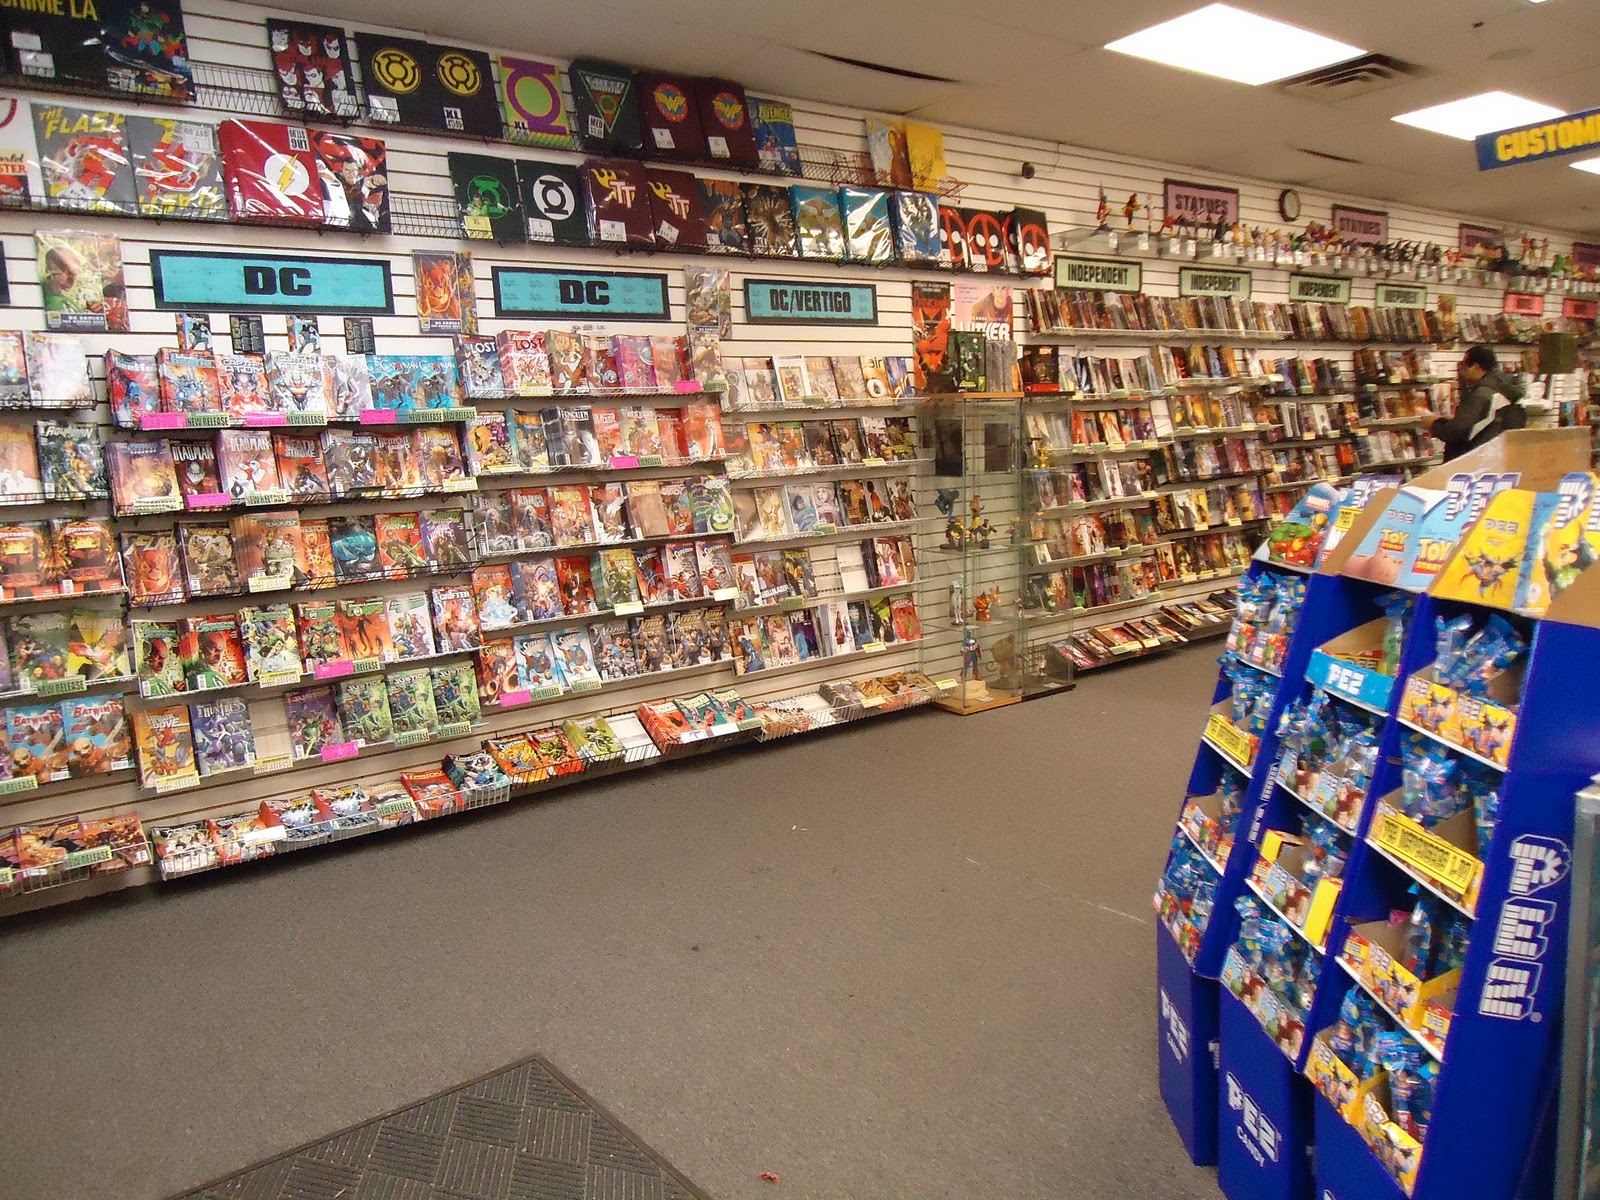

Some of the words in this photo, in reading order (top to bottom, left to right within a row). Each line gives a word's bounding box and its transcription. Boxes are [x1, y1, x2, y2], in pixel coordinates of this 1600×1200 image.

[1175, 193, 1230, 217] STATUES
[243, 265, 313, 298] DC
[1067, 263, 1129, 286] INDEPENDENT
[1190, 273, 1242, 293] INDEPENDENT
[558, 278, 610, 306] DC
[769, 287, 852, 314] DC/VERTIGO
[470, 341, 497, 354] LOST
[514, 337, 544, 350] LOST
[224, 365, 265, 374] ATOM
[203, 416, 229, 427] RELEASE
[301, 415, 326, 425] RELEASE
[421, 412, 443, 422] RELEASE
[454, 410, 476, 420] RELEASE
[285, 448, 316, 459] STROKE
[1387, 508, 1416, 525] PEZ
[1484, 518, 1519, 534] PEZ
[1380, 528, 1410, 544] TOY
[1419, 537, 1453, 562] TOY
[1414, 560, 1445, 573] STORY
[439, 590, 470, 601] GRIFTER
[355, 662, 380, 673] RELEASE
[1327, 663, 1366, 696] PEZ
[73, 701, 123, 721] BATWING
[13, 711, 62, 729] BATWING
[409, 732, 430, 743] RELEASE
[450, 724, 471, 735] RELEASE
[393, 800, 413, 812] RELEASE
[1478, 834, 1572, 1021] PEZ
[1160, 986, 1189, 1059] PEZ
[1226, 1071, 1280, 1163] PEZ
